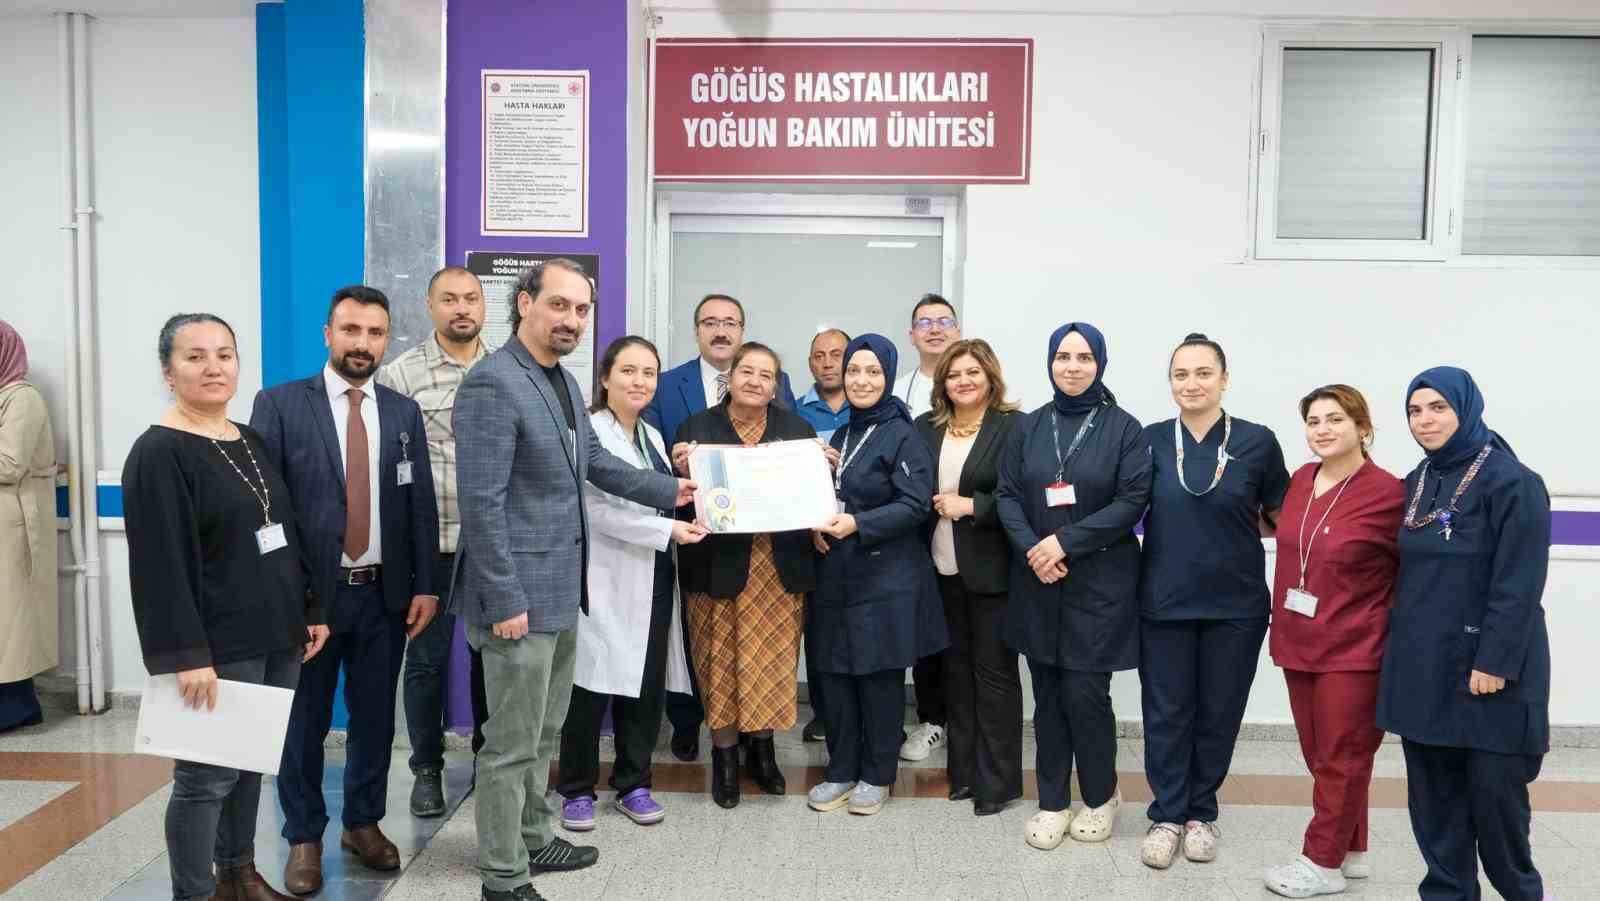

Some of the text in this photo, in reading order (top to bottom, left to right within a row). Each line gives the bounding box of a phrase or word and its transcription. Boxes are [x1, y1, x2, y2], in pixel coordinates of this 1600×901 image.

[691, 67, 988, 103] GÖĞÜS HASTALIKLARI
[504, 101, 566, 110] HASTA HAKLARI
[683, 111, 995, 148] YOĞUN BAKIM ÜNİTESİ
[492, 258, 519, 266] GÖĞÜS
